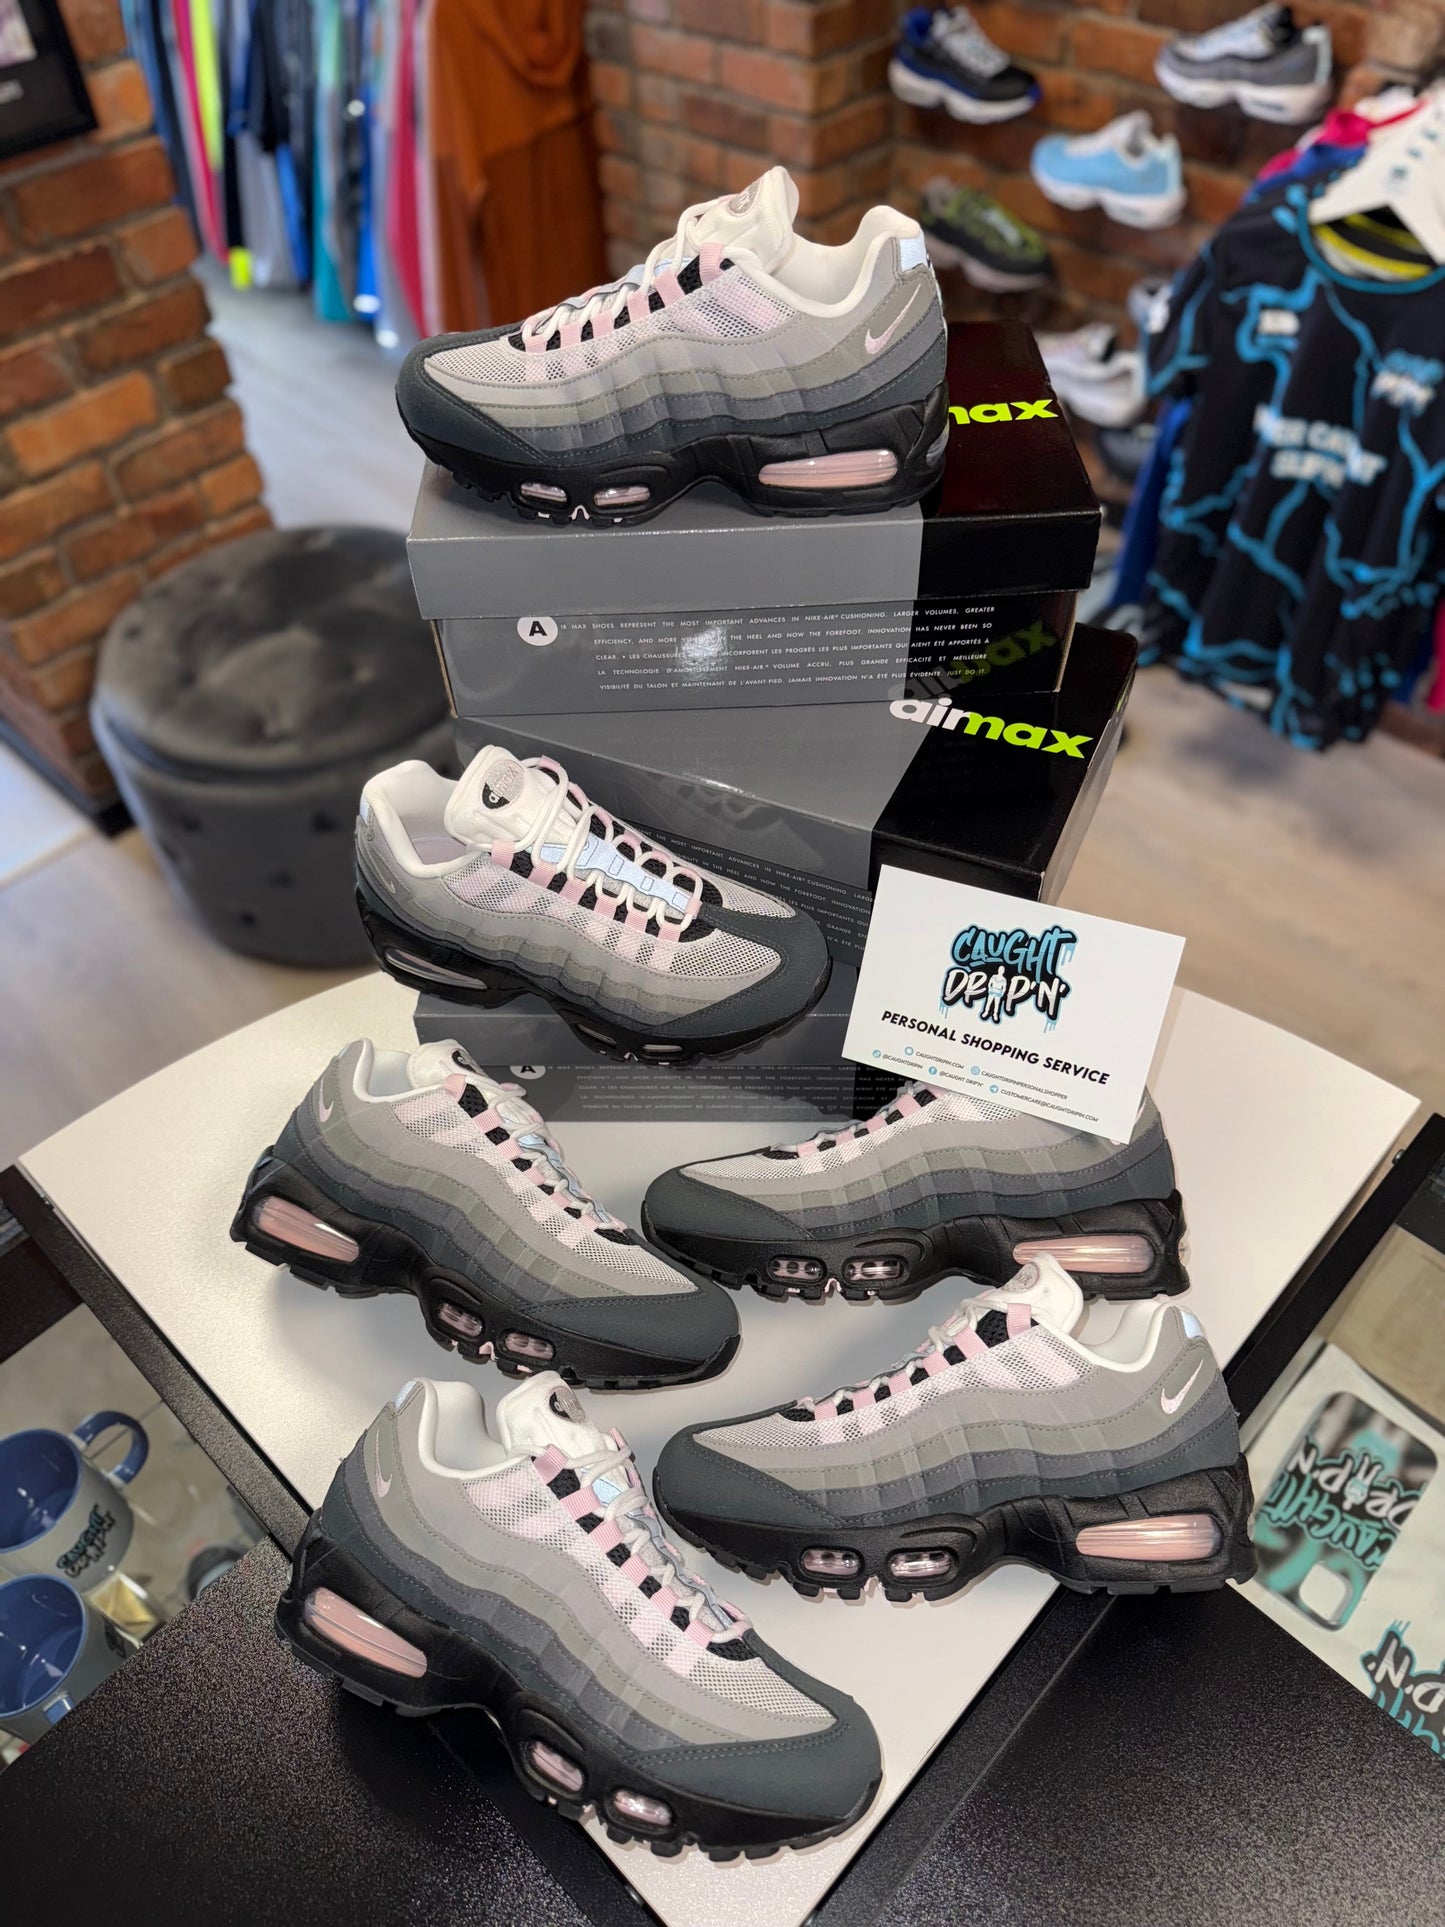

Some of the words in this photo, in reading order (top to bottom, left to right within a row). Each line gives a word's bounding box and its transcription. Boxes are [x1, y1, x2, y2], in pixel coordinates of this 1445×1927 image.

[705, 618, 743, 626] IMPORTANT
[749, 616, 786, 624] ADVANCES
[925, 608, 959, 616] VOLUMES,
[965, 606, 995, 614] GREATER
[867, 626, 911, 634] INNOVATION
[850, 643, 893, 651] IMPORTANTS
[860, 658, 889, 666] GRANDE
[952, 653, 987, 661] MEILLEURE
[889, 698, 1094, 759] airmax
[670, 839, 687, 847] MOST
[691, 845, 724, 858] IMPORTANT
[728, 855, 760, 869] ADVANCES
[712, 863, 723, 871] THE
[726, 868, 740, 877] HEEL
[743, 873, 757, 881] AND
[760, 878, 776, 886] NOW
[831, 899, 871, 915] INNOVATION
[800, 903, 815, 911] PLUS
[816, 907, 854, 923] IMPORTANTS
[826, 923, 851, 935] GRANDE
[854, 943, 865, 951] PLU
[951, 925, 1077, 985] CAUGHT
[881, 1010, 956, 1042] PERSONAL
[961, 1033, 1040, 1065] SHOPPING
[1043, 1057, 1111, 1085] SERVICE
[939, 1070, 965, 1083] @CAUGHT
